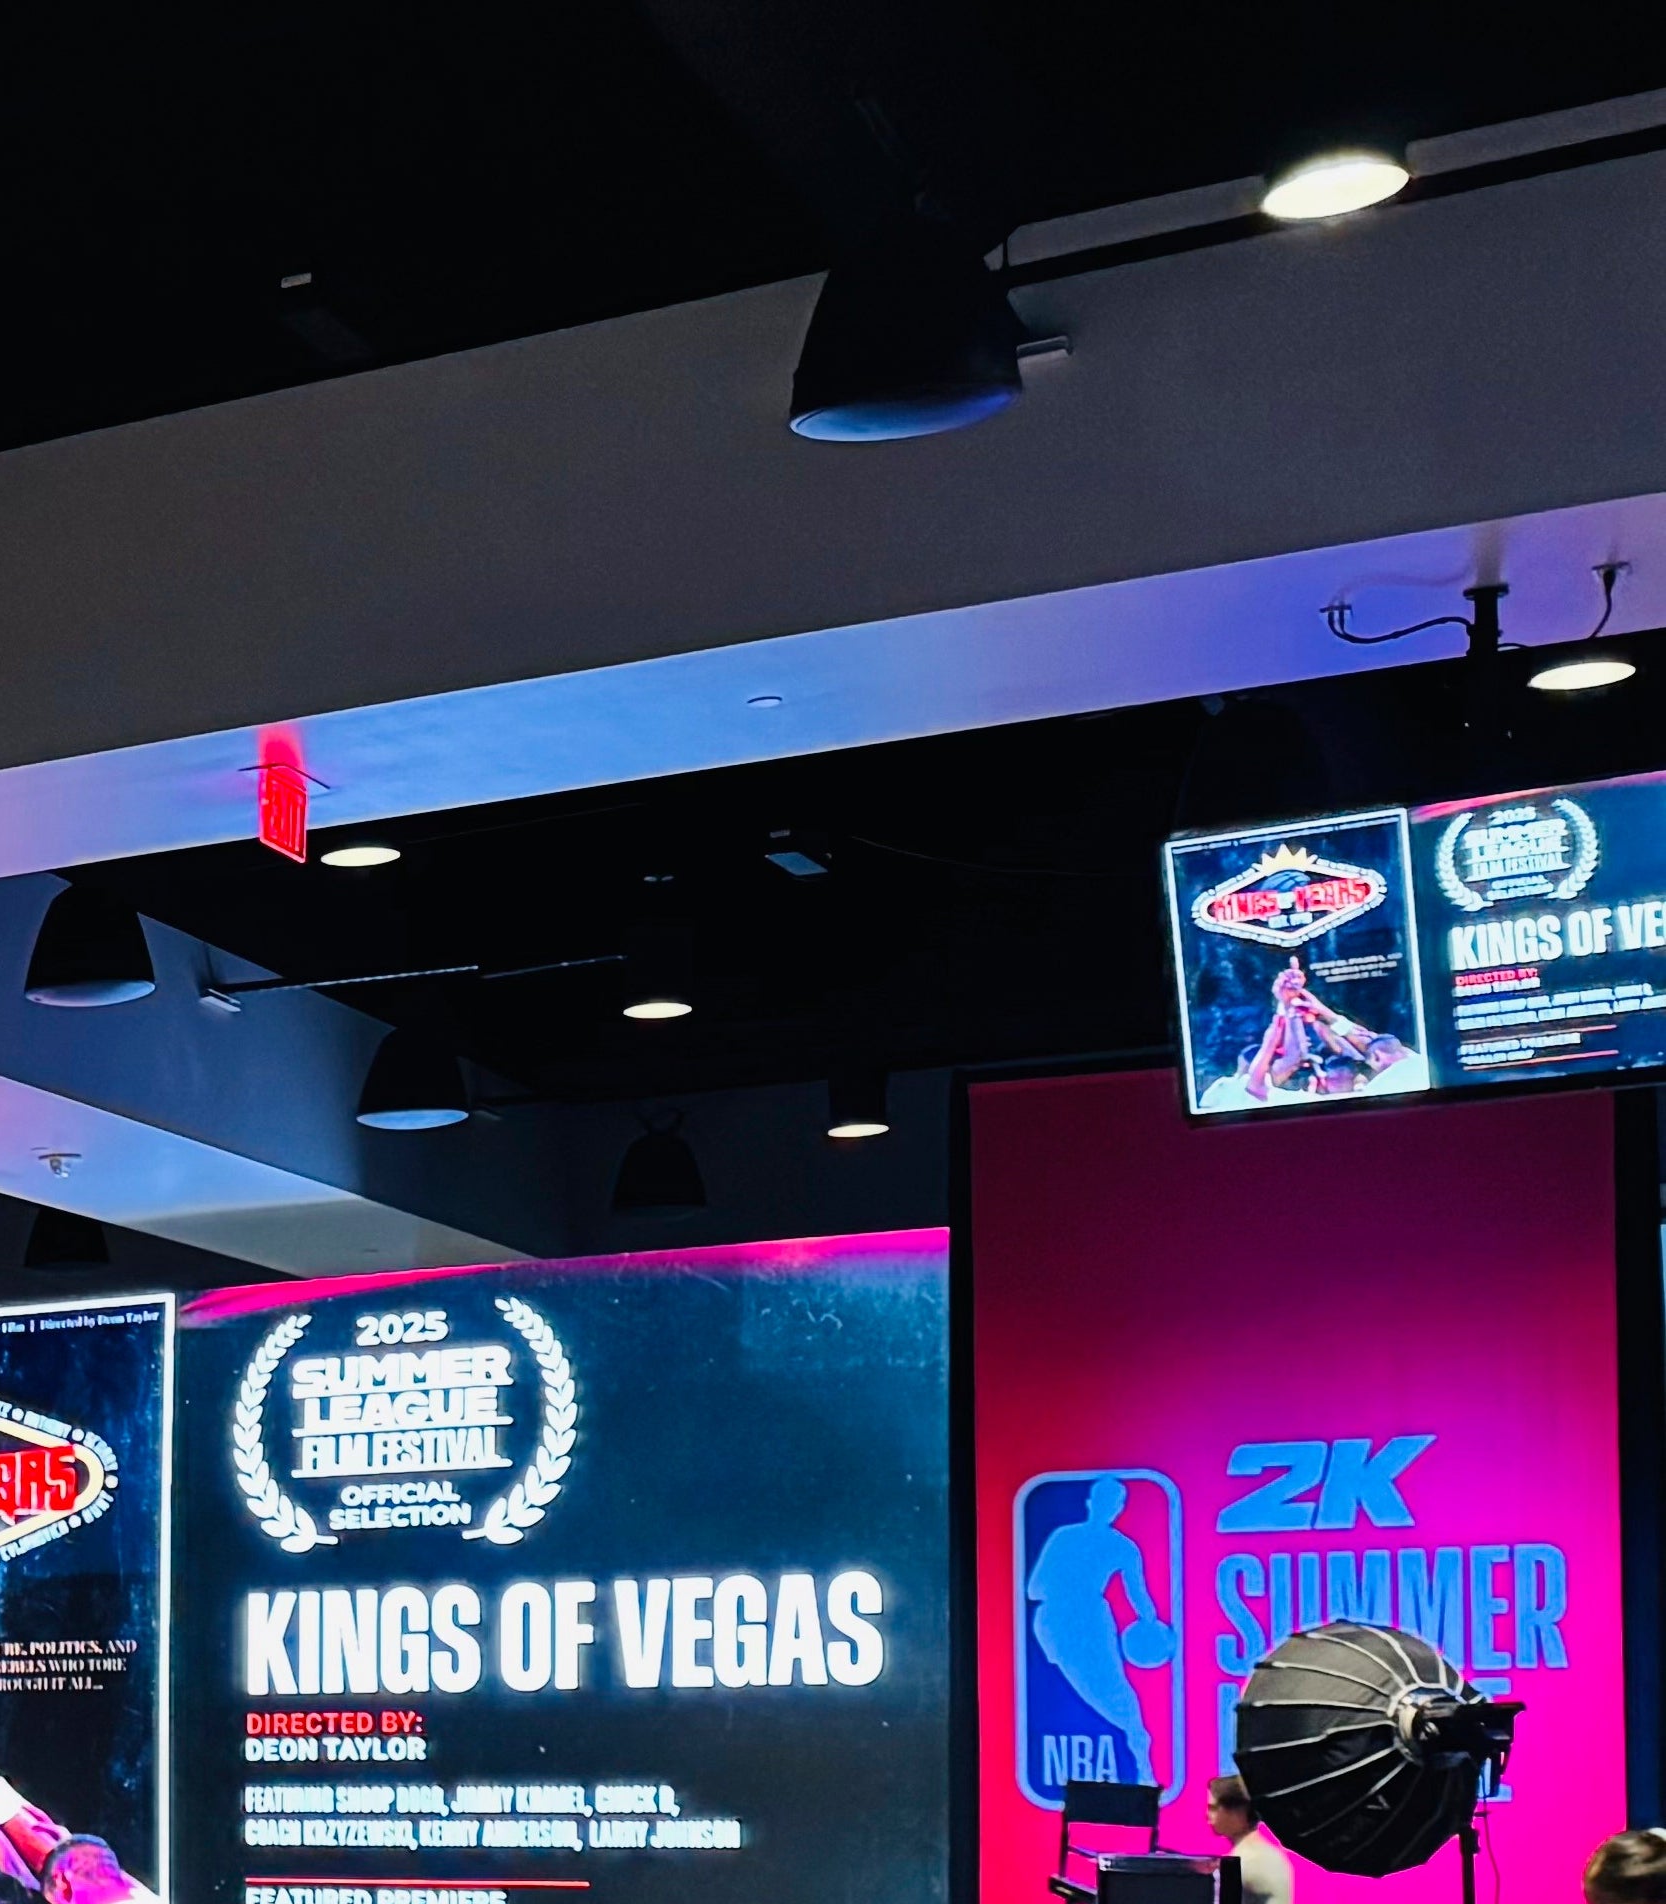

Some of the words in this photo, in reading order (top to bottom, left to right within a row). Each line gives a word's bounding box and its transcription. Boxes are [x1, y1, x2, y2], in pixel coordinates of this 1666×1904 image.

[1451, 915, 1563, 970] KINGS
[1568, 907, 1613, 957] OF
[1618, 901, 1666, 951] VE
[1455, 970, 1516, 986] DIRECTED
[356, 1310, 449, 1347] 2025
[292, 1346, 514, 1399] SUMMER
[298, 1386, 506, 1433] LEAGUE
[302, 1434, 369, 1475] FILM
[372, 1426, 497, 1468] FESTIVAL
[340, 1481, 461, 1506] OFFICIAL
[1216, 1434, 1437, 1533] 2K
[329, 1503, 472, 1530] SELECTION
[30, 1640, 103, 1656] POLITICS,
[105, 1639, 137, 1654] AND
[245, 1583, 482, 1697] KINGS
[499, 1579, 596, 1691] OF
[613, 1569, 885, 1689] VEGAS
[48, 1658, 84, 1673] WHO
[88, 1657, 127, 1672] TORE
[51, 1676, 67, 1691] IT
[246, 1712, 373, 1735] DIRECTED
[381, 1711, 423, 1733] BY:
[245, 1736, 318, 1761] DEON
[322, 1736, 427, 1761] TAYLOR
[1042, 1735, 1120, 1786] NBA
